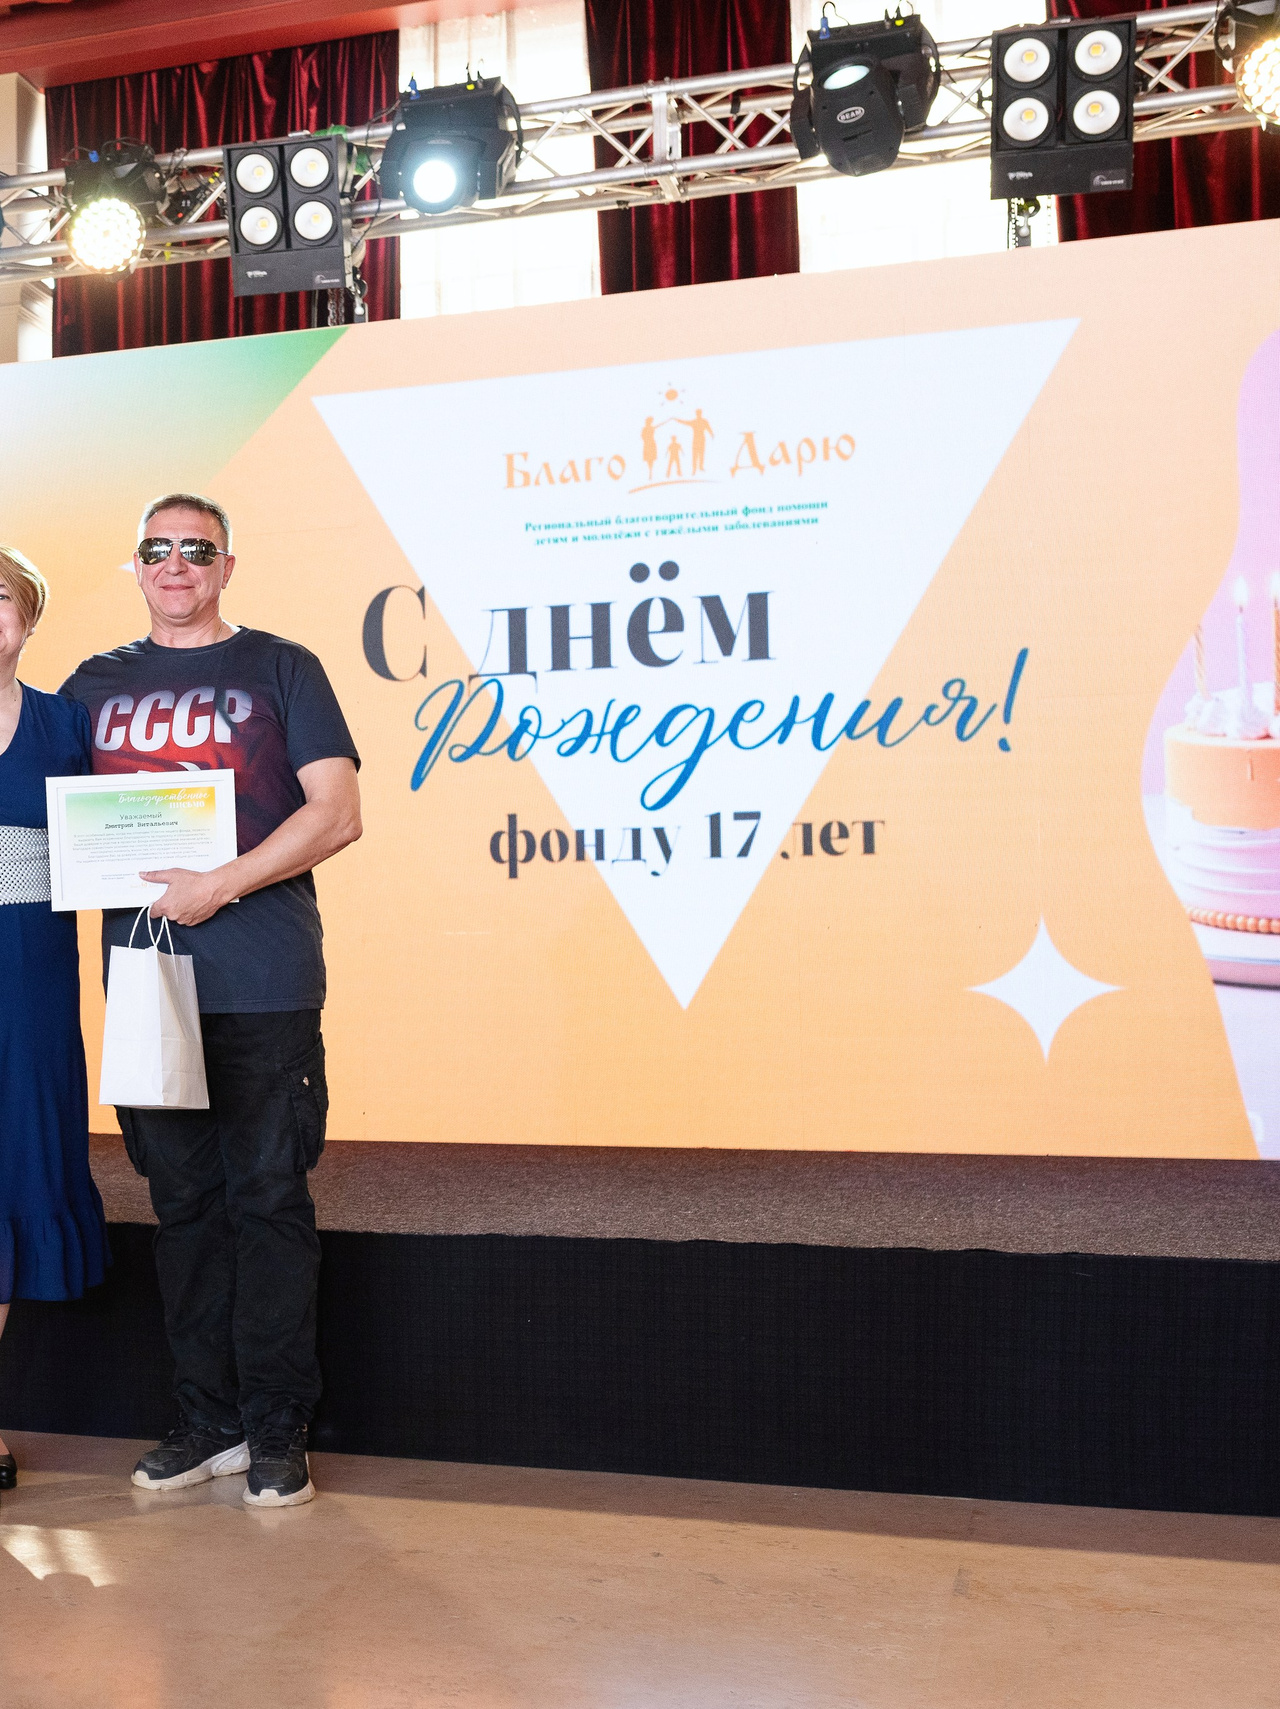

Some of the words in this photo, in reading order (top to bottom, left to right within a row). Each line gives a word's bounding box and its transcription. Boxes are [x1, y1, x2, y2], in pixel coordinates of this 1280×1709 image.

[503, 450, 626, 490] Благо
[729, 430, 857, 478] Дарю
[524, 515, 613, 532] Региональный
[615, 506, 738, 525] благотворительный
[741, 504, 774, 518] фонд
[777, 500, 829, 513] помощи
[533, 536, 569, 546] детям
[571, 535, 579, 543] и
[644, 530, 651, 538] с
[724, 516, 820, 532] заболеваниями
[361, 584, 428, 683] С
[467, 559, 777, 693] днём
[94, 685, 253, 752] СССР
[408, 646, 1030, 812] Рождения!
[489, 812, 682, 880] фонду
[704, 810, 763, 860] 17
[779, 817, 887, 861] лет
